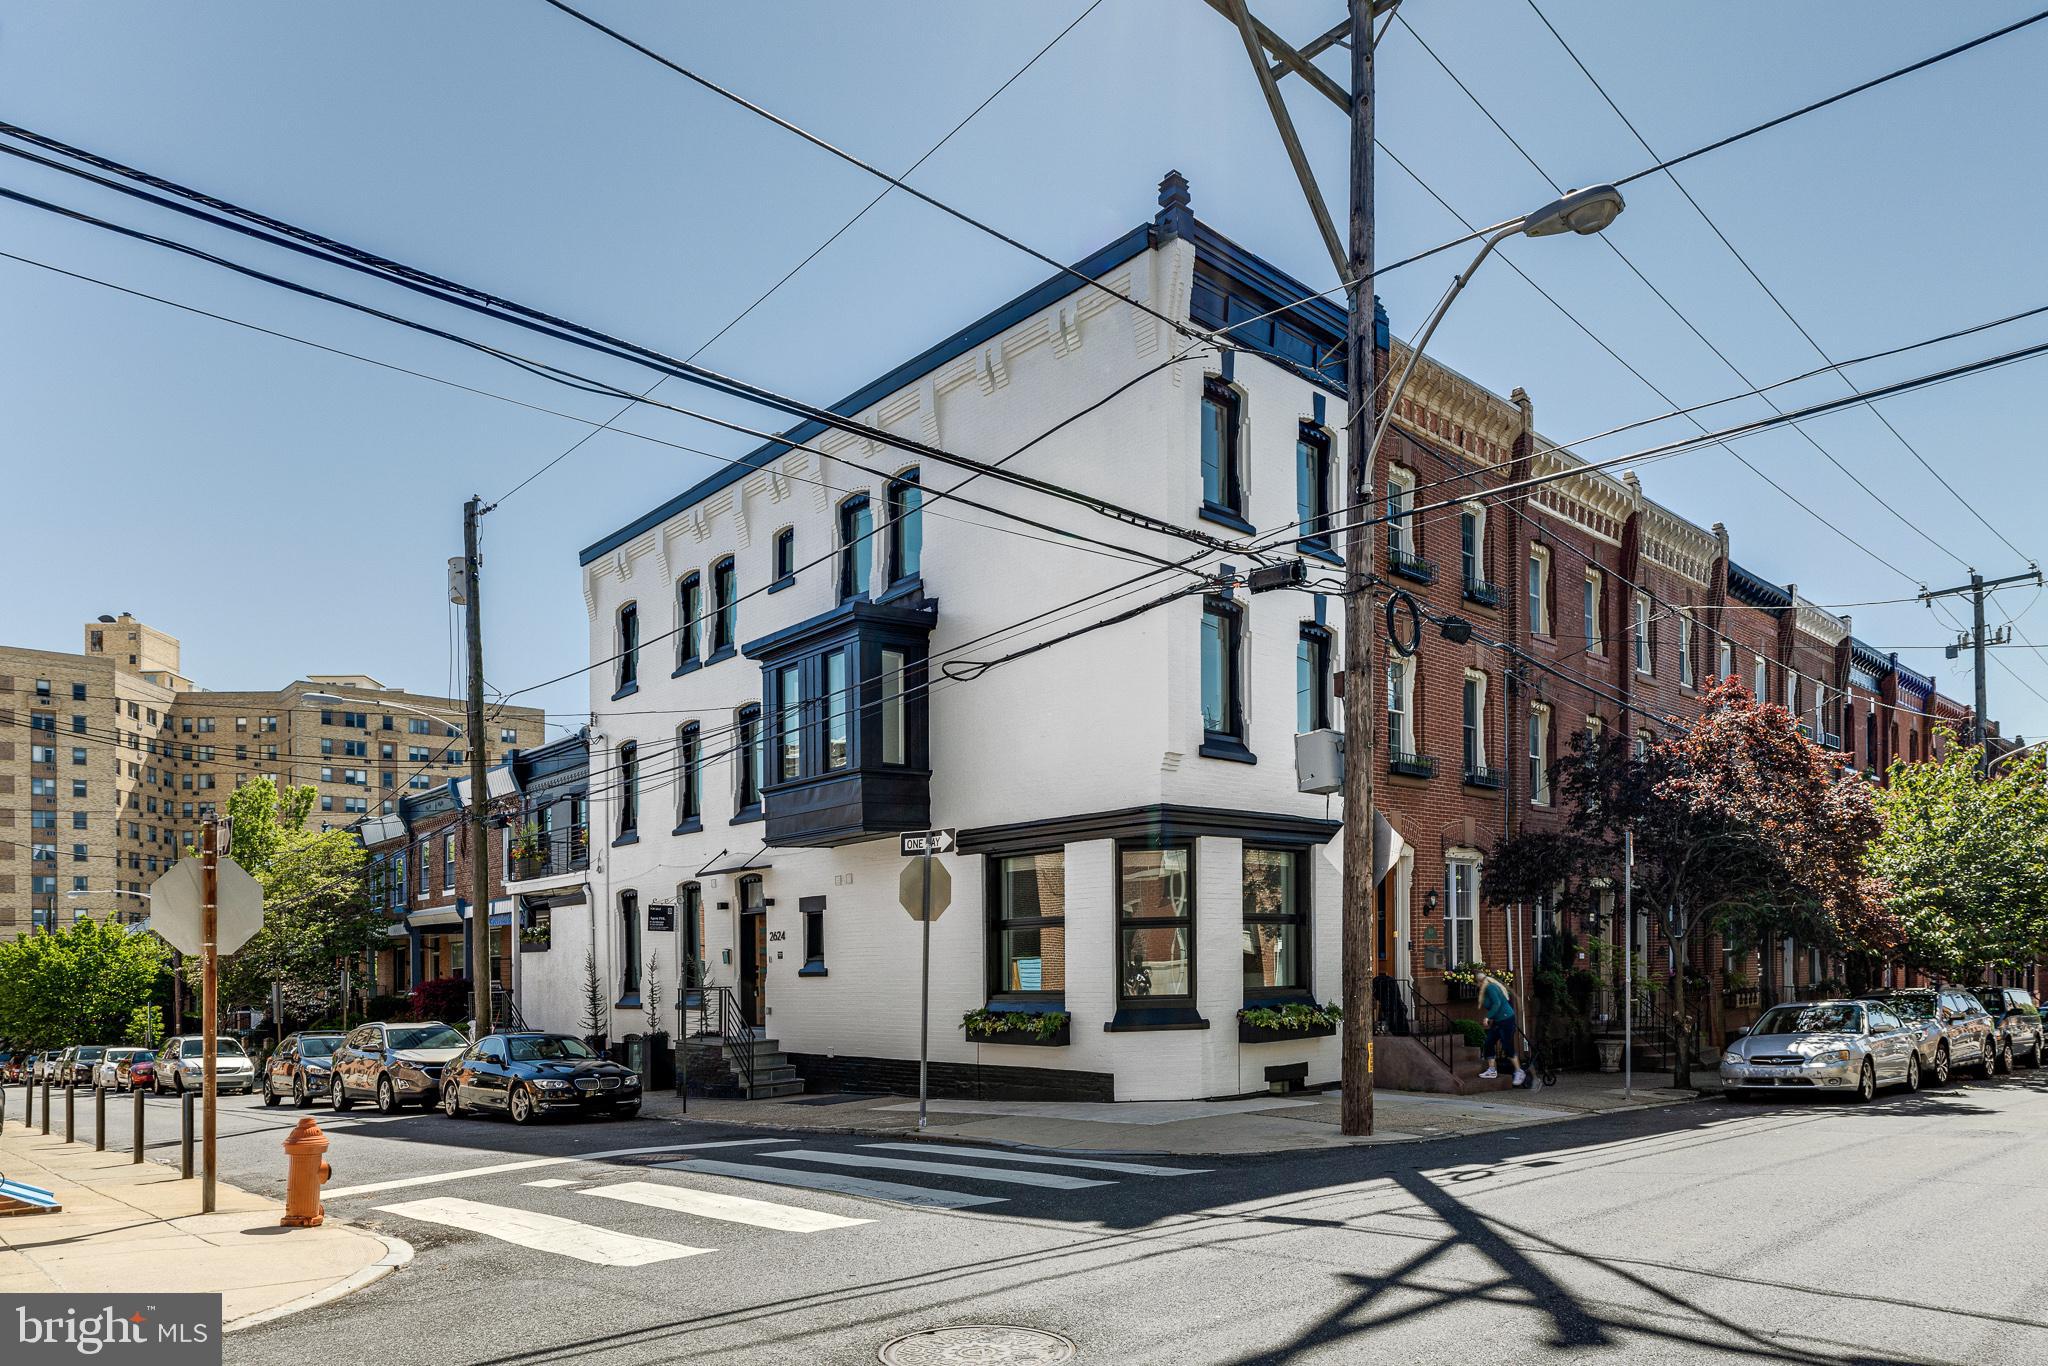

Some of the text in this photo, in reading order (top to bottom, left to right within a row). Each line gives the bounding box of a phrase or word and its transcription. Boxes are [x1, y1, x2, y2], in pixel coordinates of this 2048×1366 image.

[907, 837, 941, 849] ONE AY
[769, 931, 785, 941] 2624
